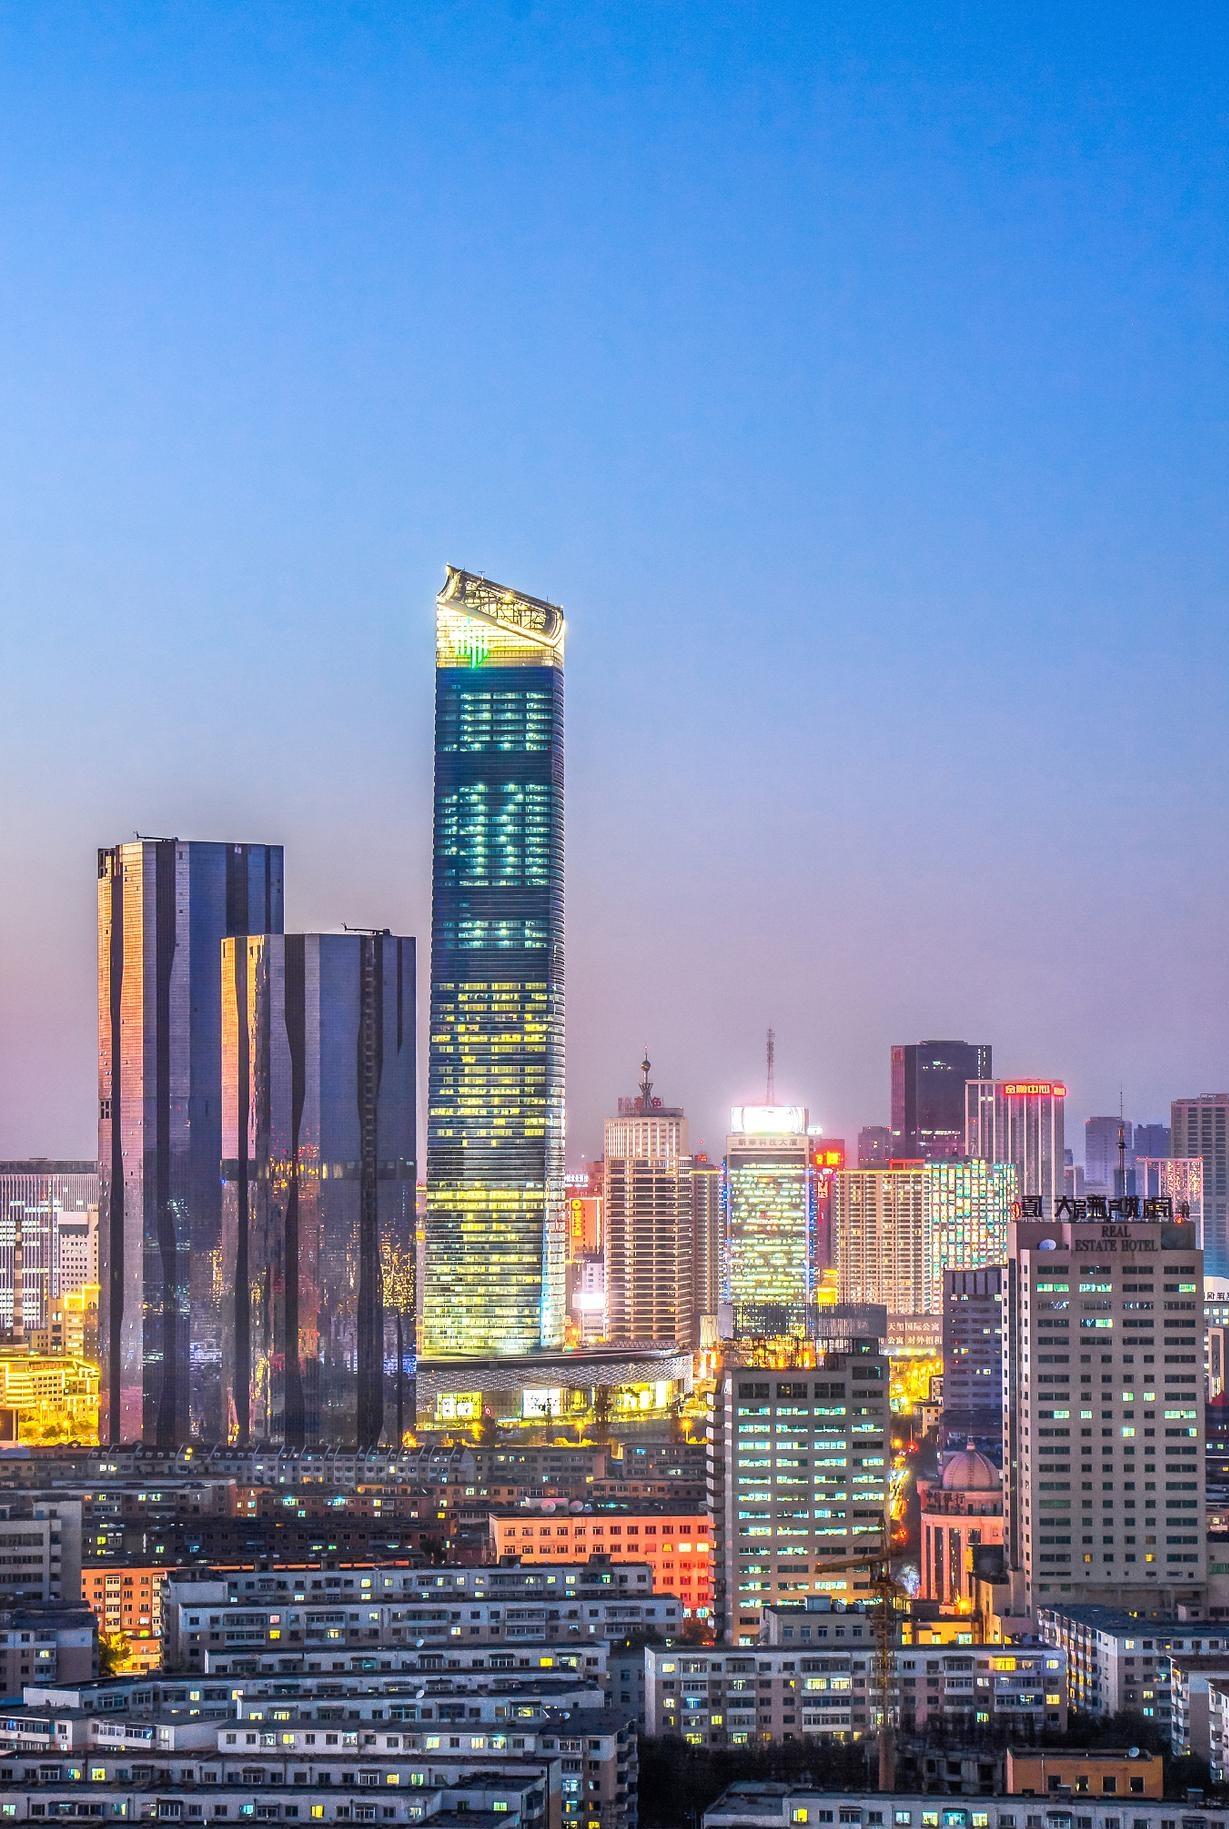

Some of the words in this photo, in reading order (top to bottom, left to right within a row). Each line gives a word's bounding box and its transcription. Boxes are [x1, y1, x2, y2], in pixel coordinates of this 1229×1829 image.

[1102, 1225, 1131, 1238] REAL
[1075, 1239, 1117, 1252] ESTATE
[1122, 1239, 1158, 1252] HOTEL
